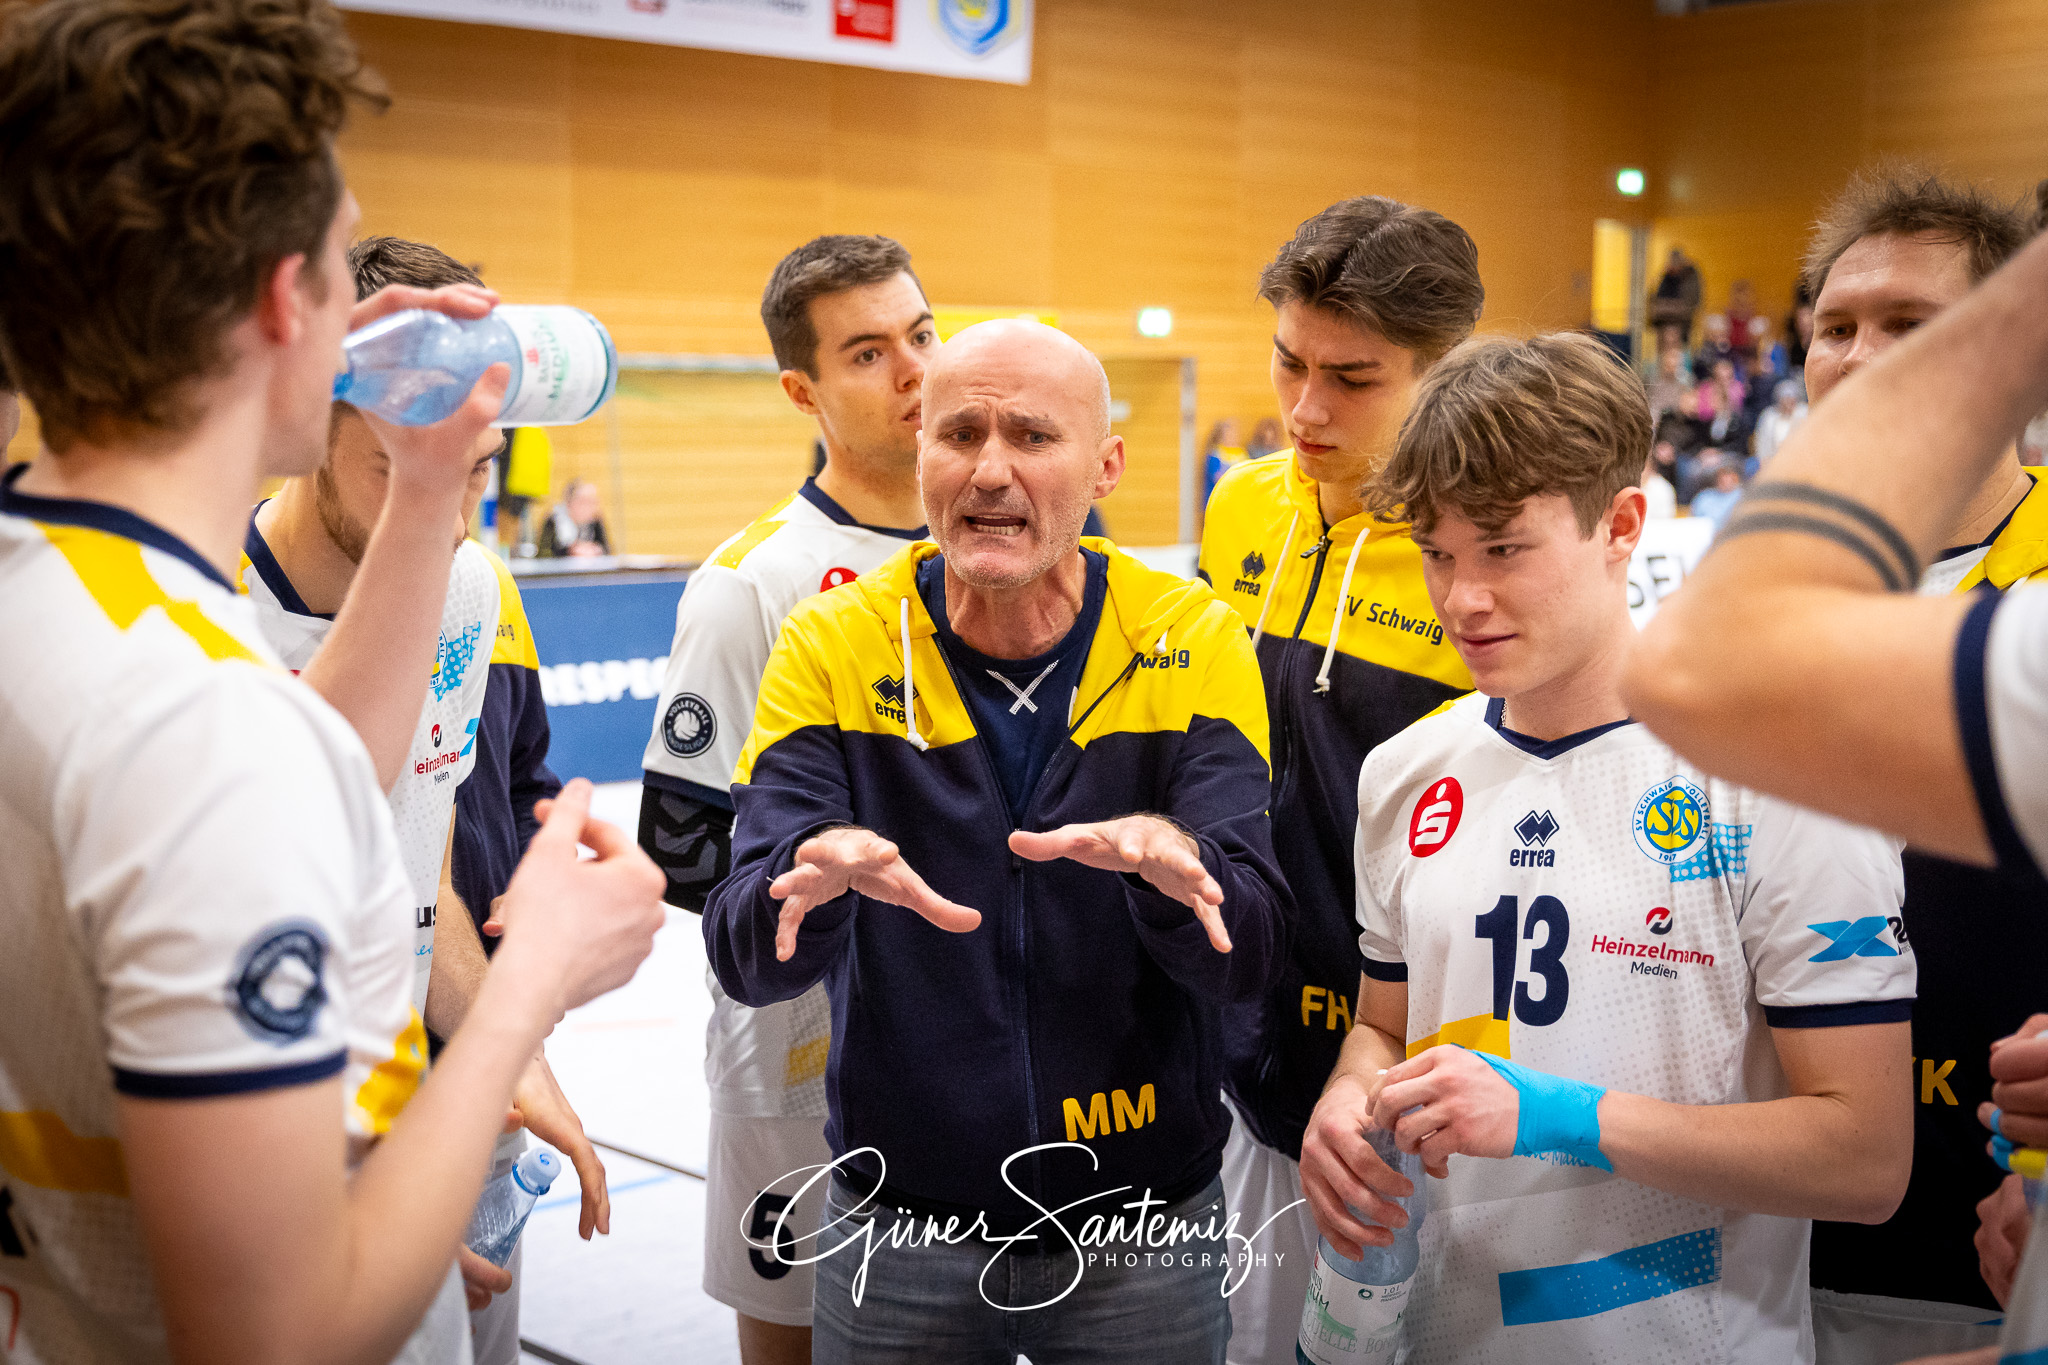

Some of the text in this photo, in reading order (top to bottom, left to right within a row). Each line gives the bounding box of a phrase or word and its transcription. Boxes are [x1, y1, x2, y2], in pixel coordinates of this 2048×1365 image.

[1234, 578, 1261, 596] errea
[1335, 594, 1444, 646] V Schwaig
[1139, 648, 1190, 669] waig
[668, 700, 710, 726] VOLLEYBALL
[875, 702, 917, 724] erre
[1635, 819, 1643, 831] SV
[1684, 783, 1711, 840] VOLLEYBALL
[1509, 849, 1555, 867] errea
[1475, 895, 1570, 1027] 13
[1591, 934, 1715, 967] Heinzelmann
[1630, 961, 1678, 979] Medien
[1301, 985, 1352, 1034] FH
[1912, 1056, 1959, 1105] K
[1062, 1083, 1155, 1141] MM
[749, 1190, 796, 1280] 5
